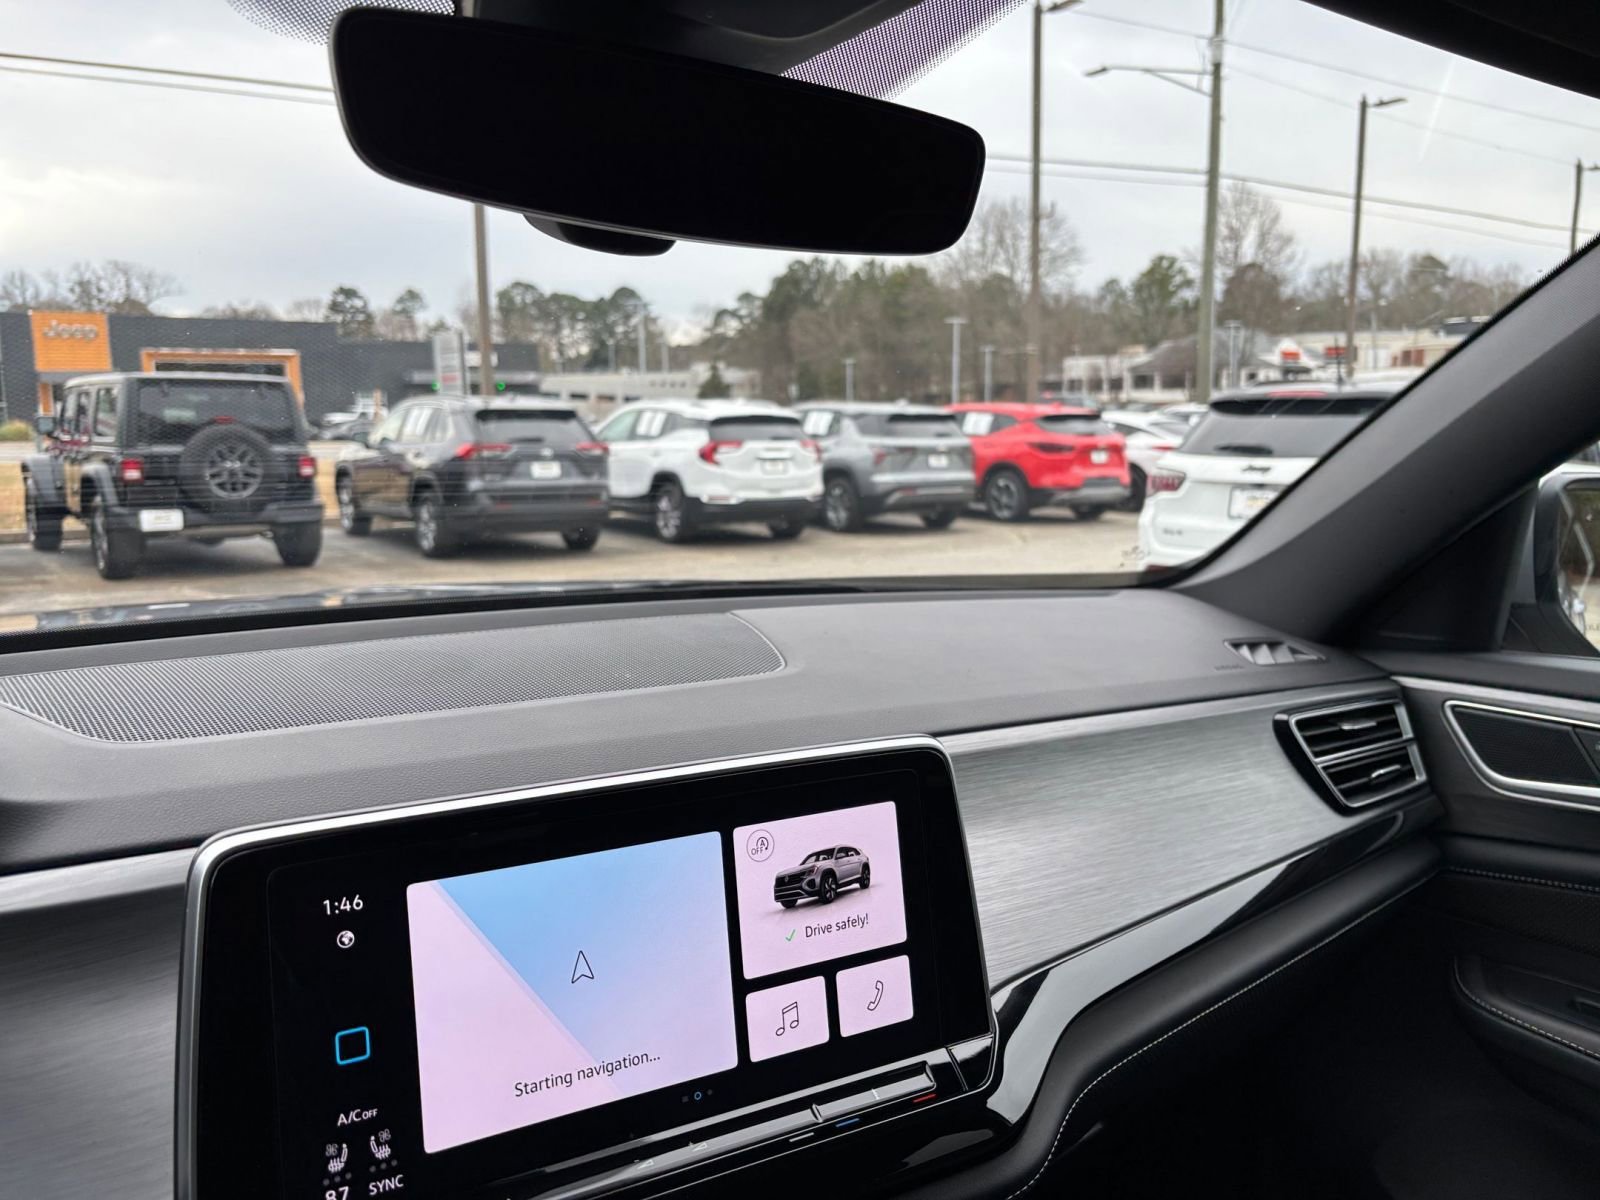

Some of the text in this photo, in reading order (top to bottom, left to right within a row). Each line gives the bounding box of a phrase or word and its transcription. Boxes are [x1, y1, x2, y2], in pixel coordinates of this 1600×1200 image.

[43, 319, 98, 343] Jeep
[323, 894, 363, 915] 1:46
[805, 912, 869, 938] Drive safely!
[514, 1052, 661, 1097] Starting navigation...
[368, 1174, 404, 1195] SYNC
